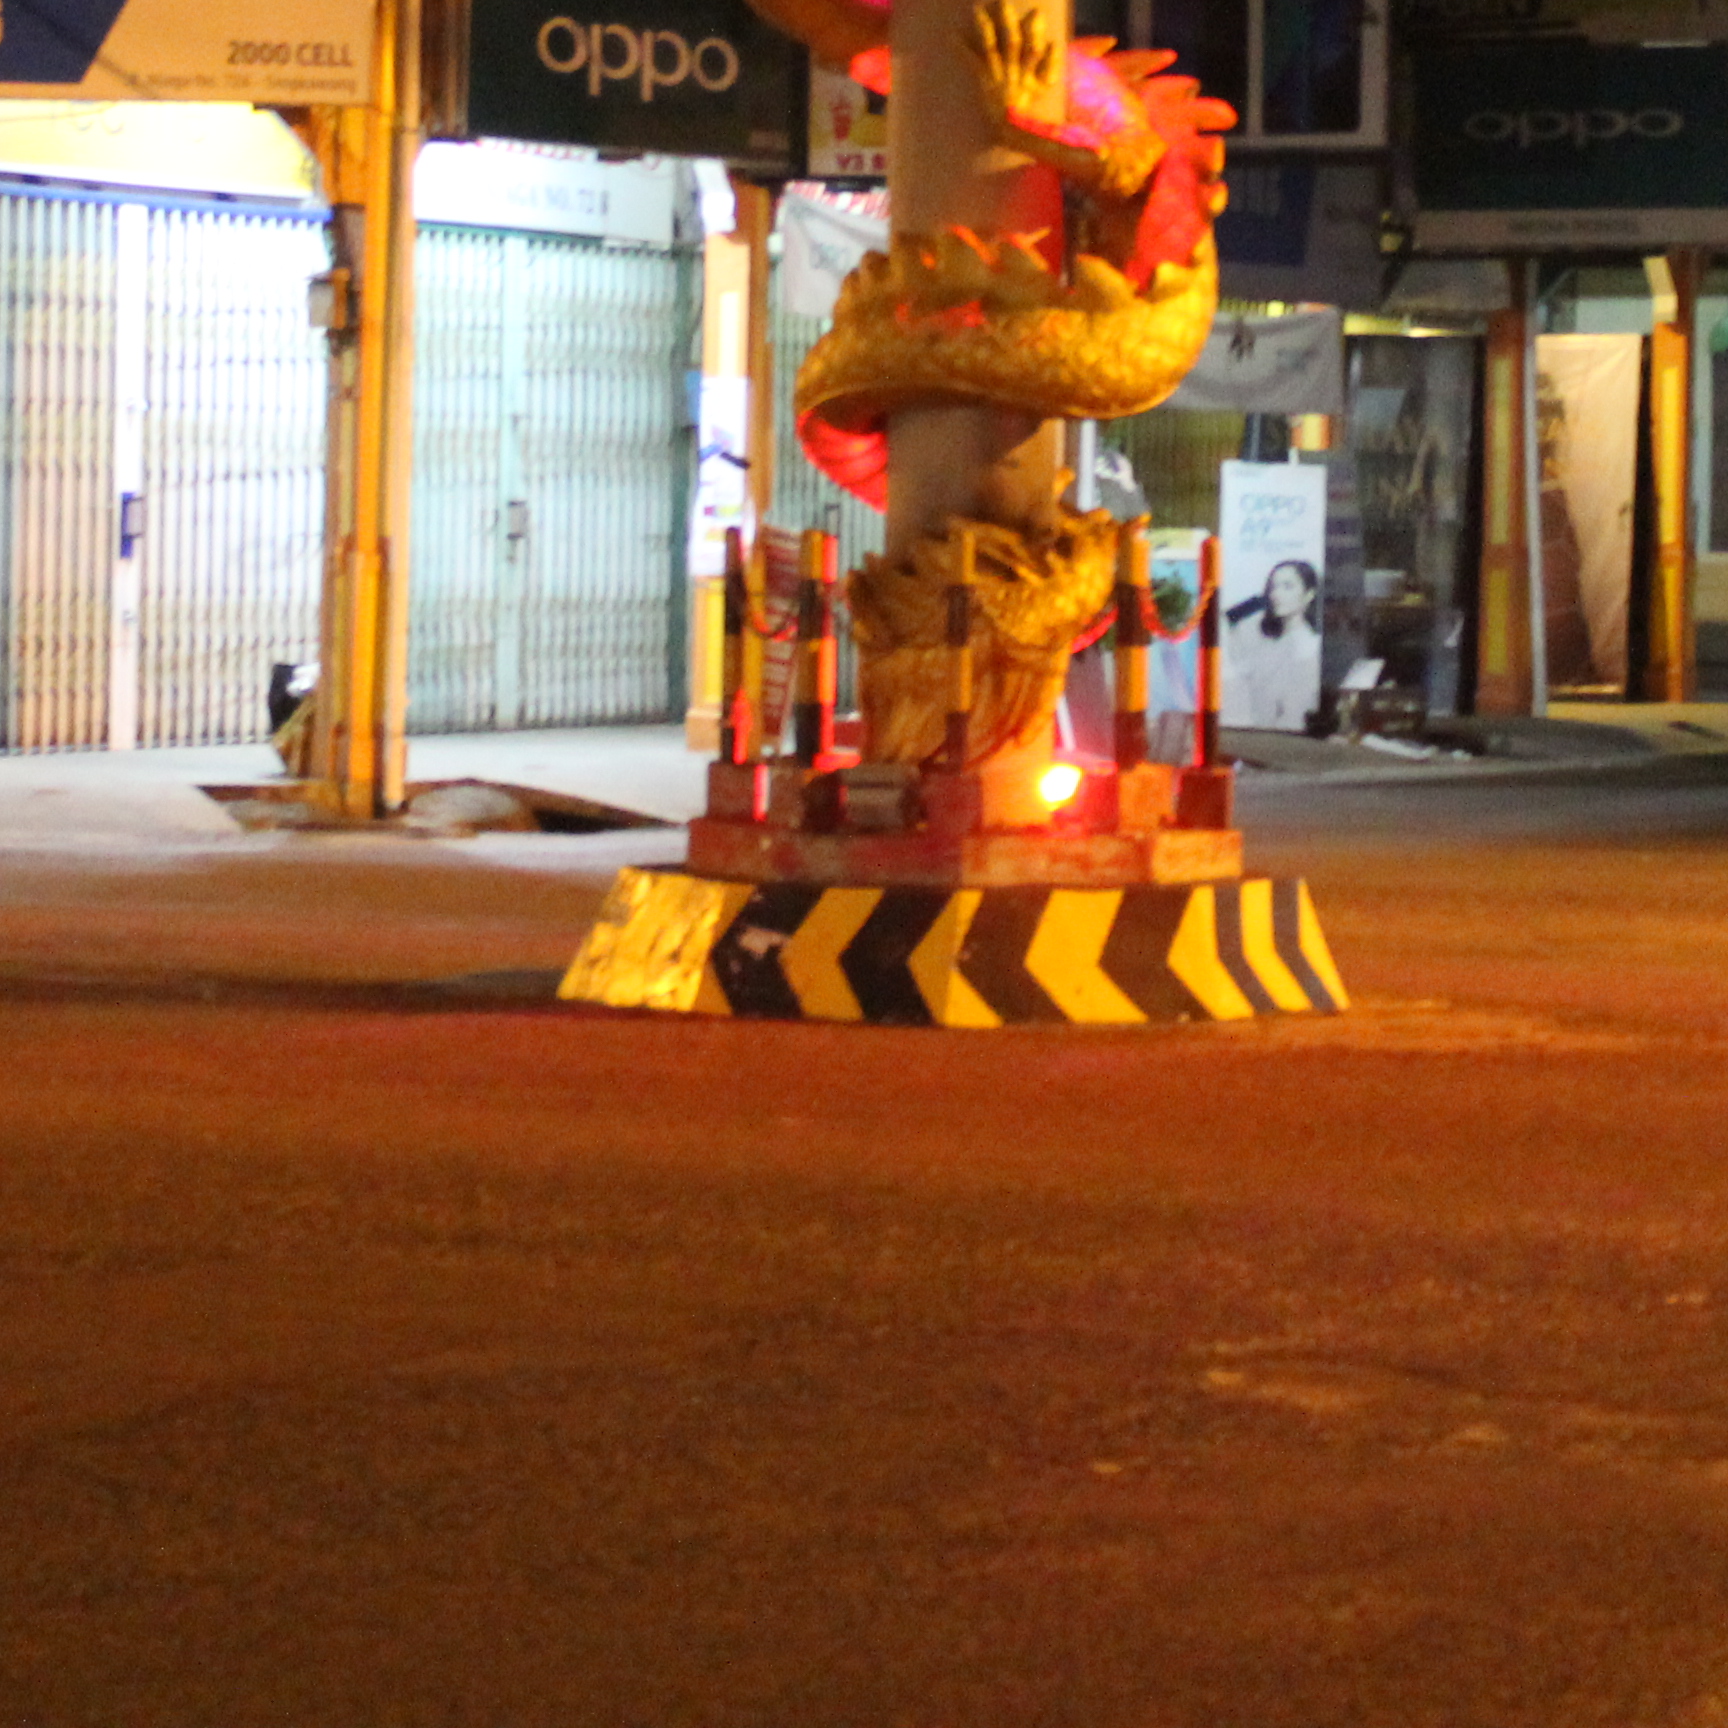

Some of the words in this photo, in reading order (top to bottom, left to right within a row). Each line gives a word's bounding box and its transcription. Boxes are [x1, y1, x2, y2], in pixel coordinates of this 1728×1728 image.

[227, 40, 291, 65] 2000
[295, 42, 354, 68] CELL
[536, 16, 739, 102] oppo
[1464, 108, 1684, 150] oppo
